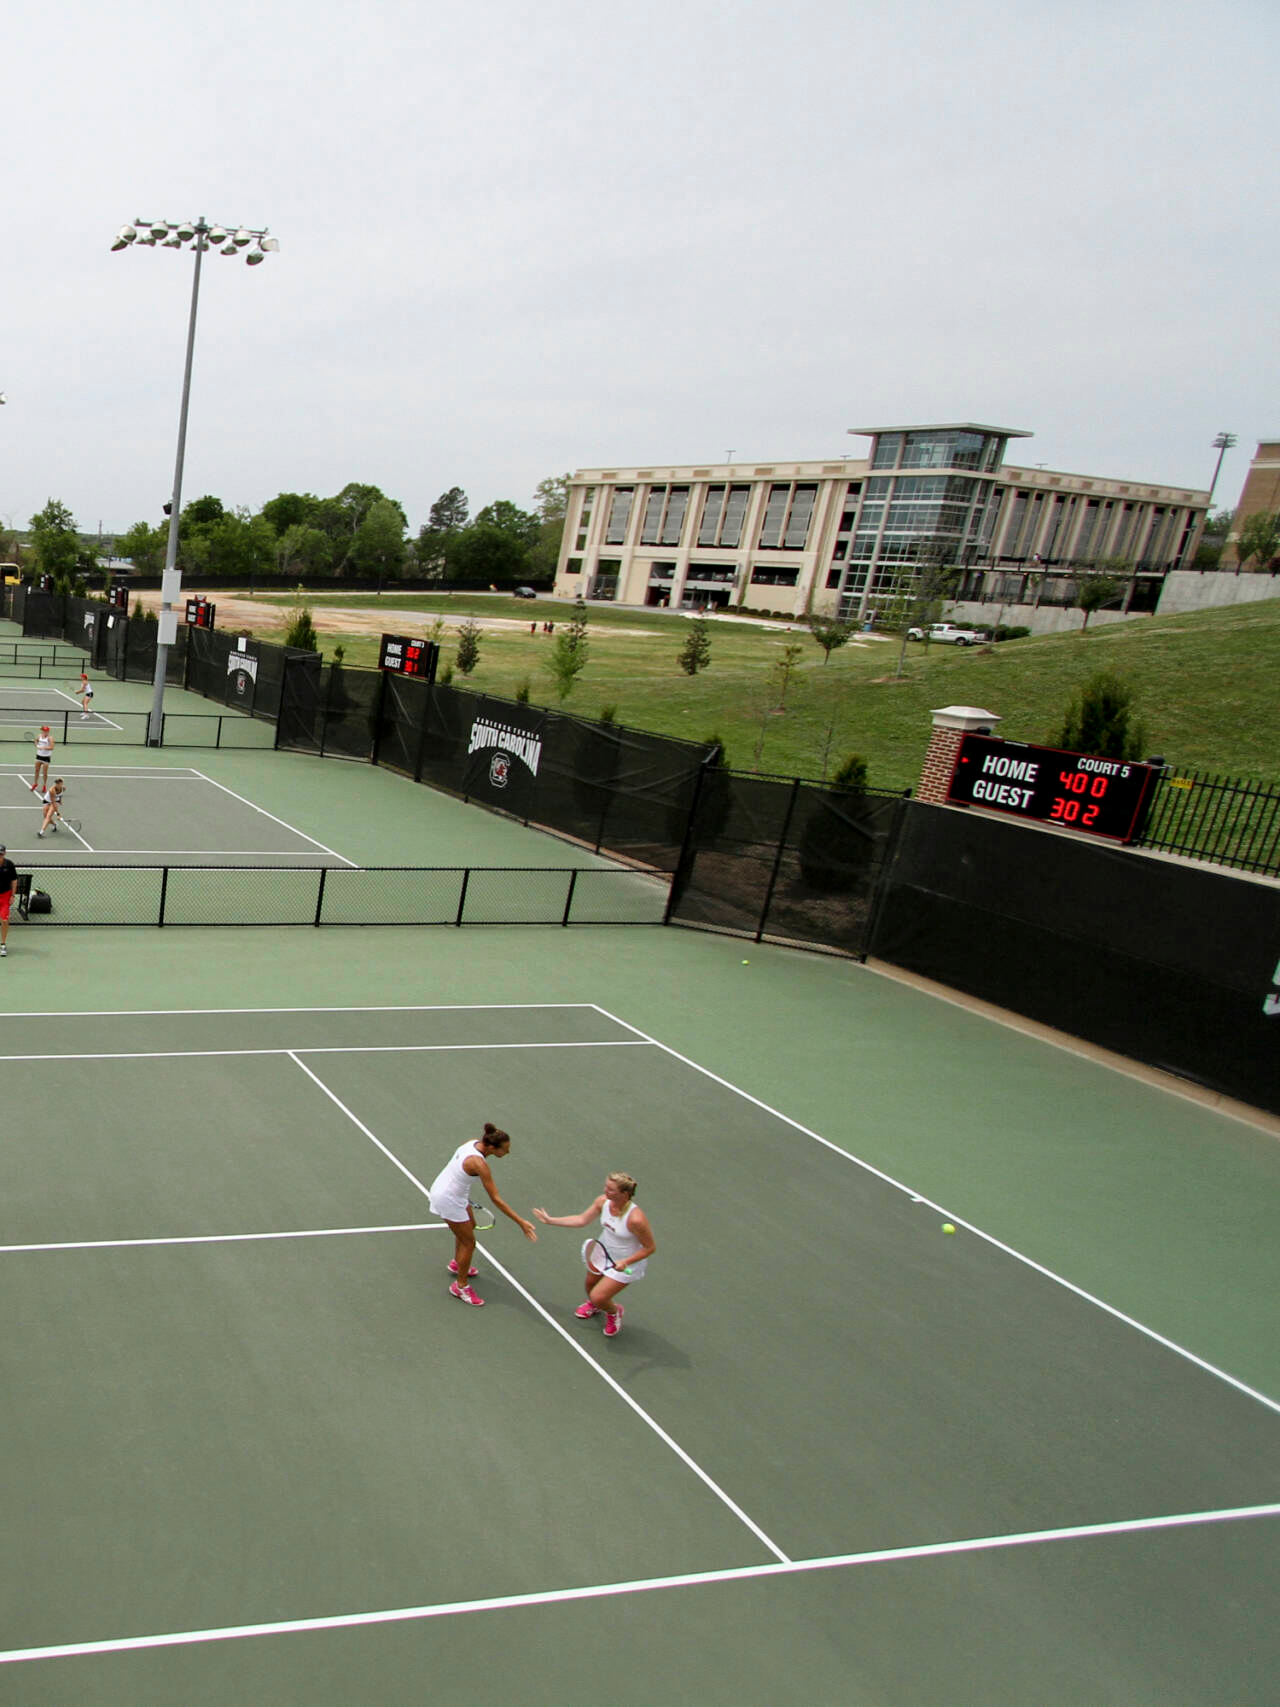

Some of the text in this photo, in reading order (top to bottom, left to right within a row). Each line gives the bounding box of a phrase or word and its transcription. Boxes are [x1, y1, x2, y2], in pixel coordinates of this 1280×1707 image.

[467, 722, 542, 777] SOUTH CAROLINA
[982, 754, 1040, 783] HOME
[1077, 757, 1131, 778] COURT 5
[972, 779, 1035, 810] GUEST
